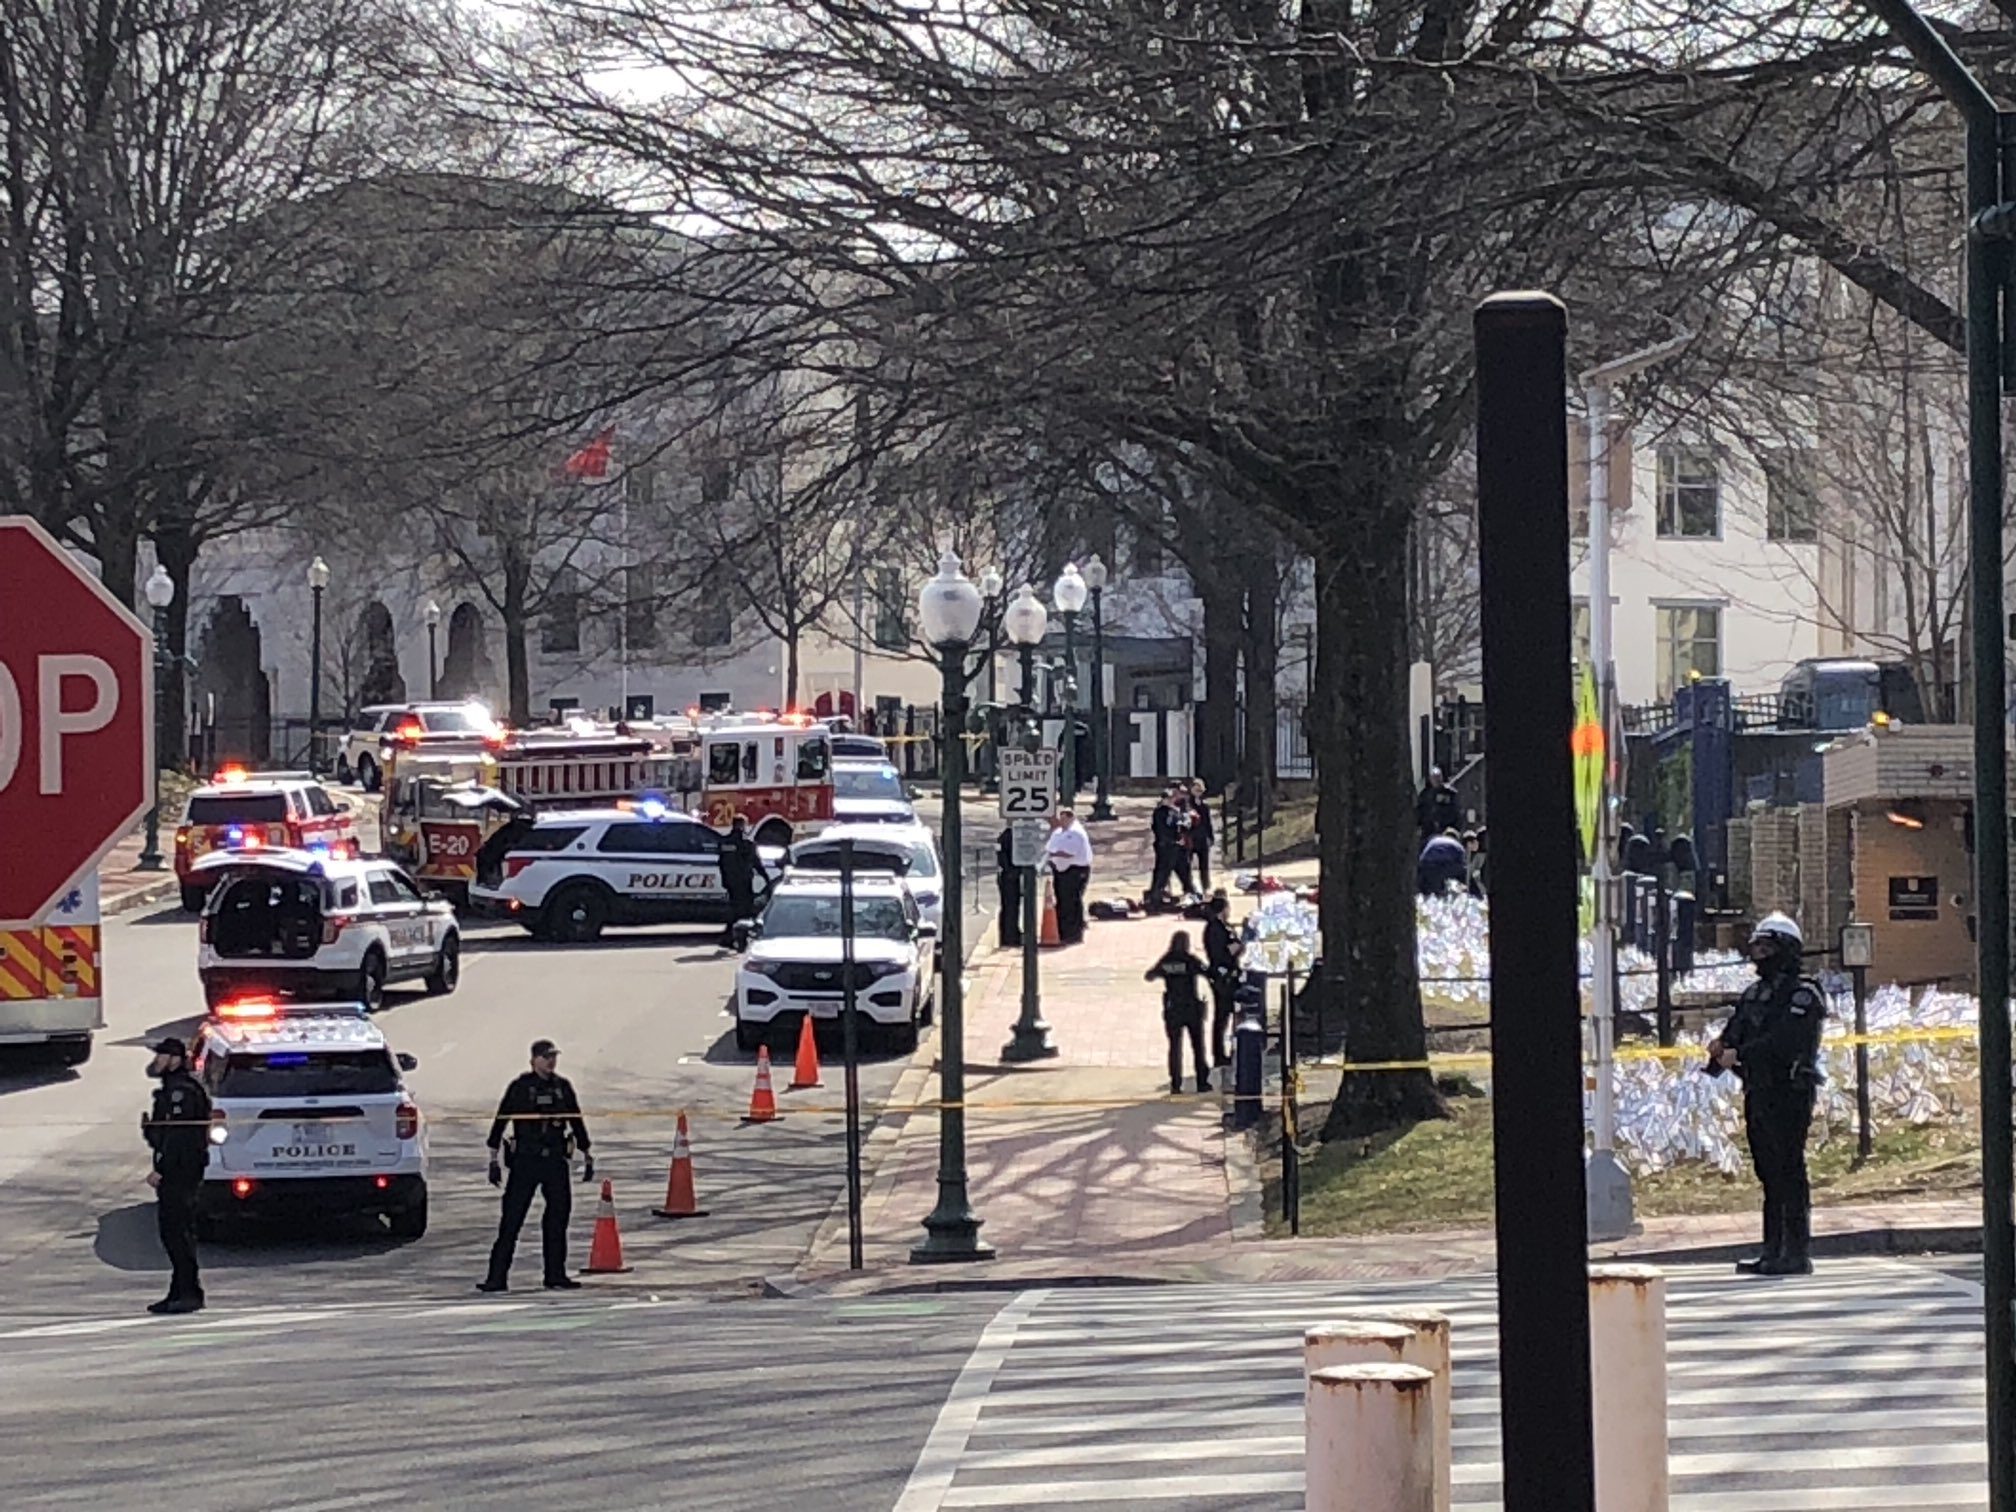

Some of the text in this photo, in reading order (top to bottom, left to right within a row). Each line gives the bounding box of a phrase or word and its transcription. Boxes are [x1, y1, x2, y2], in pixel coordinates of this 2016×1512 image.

[1004, 753, 1053, 766] SPEED
[1008, 770, 1047, 782] LIMIT
[1006, 786, 1049, 812] 25
[430, 833, 470, 856] E-20
[627, 873, 716, 889] POLICE
[272, 1144, 355, 1158] POLICE
